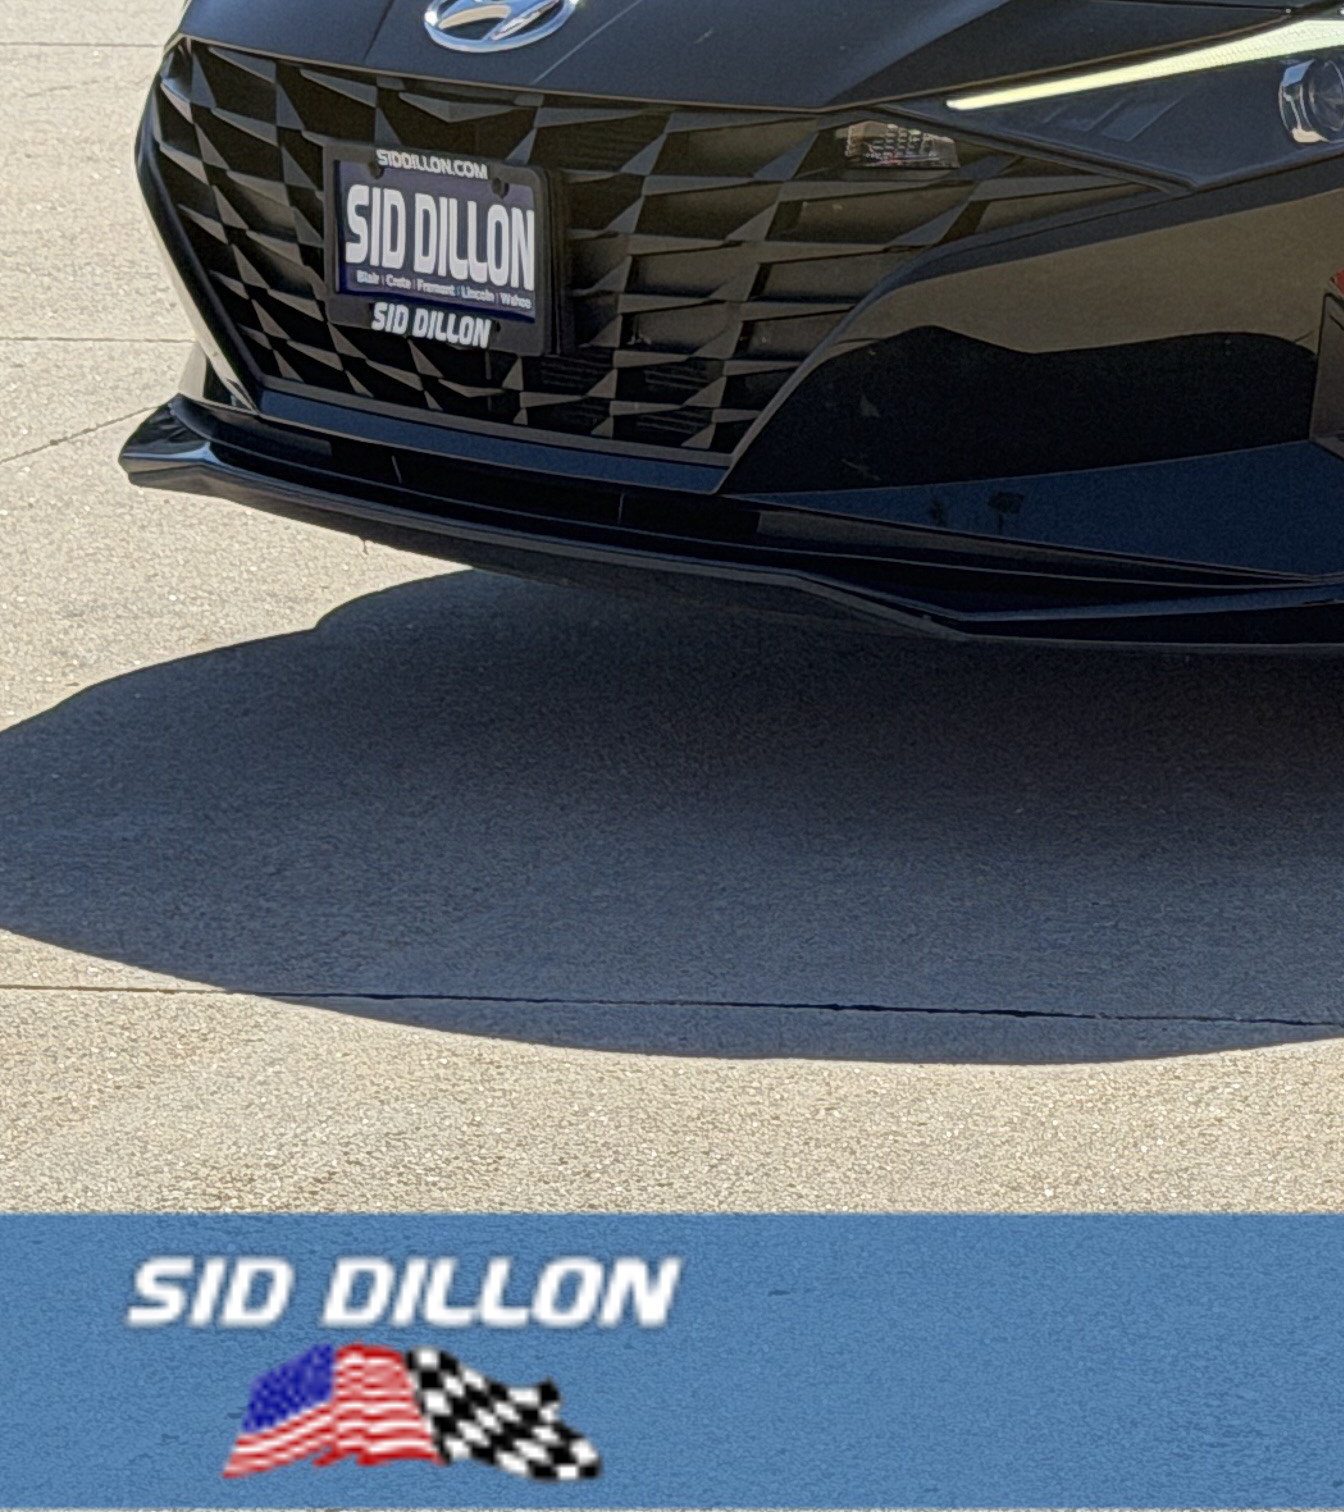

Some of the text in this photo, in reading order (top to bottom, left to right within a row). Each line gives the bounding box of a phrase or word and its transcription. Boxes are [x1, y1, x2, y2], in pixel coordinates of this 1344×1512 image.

[376, 149, 489, 180] SIDDILLON.COM
[345, 183, 535, 291] SID DILLON
[371, 302, 492, 349] SID DILLON
